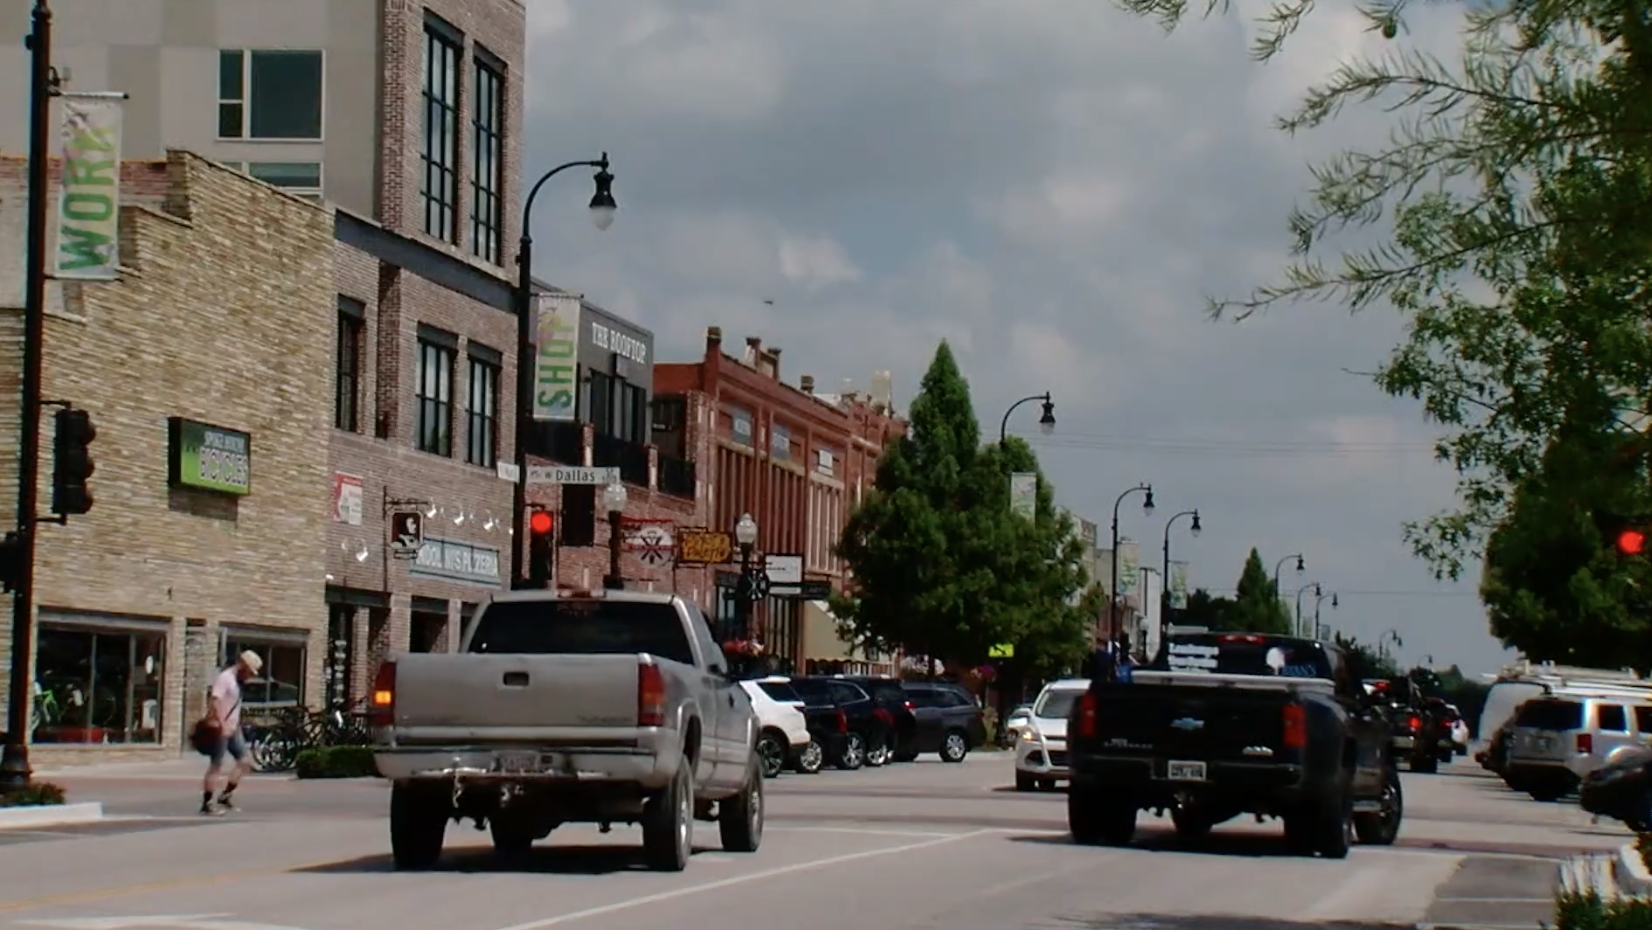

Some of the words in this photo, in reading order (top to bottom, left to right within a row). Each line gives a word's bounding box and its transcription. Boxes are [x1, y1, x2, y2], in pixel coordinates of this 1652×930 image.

[58, 123, 116, 271] WORK
[537, 313, 575, 408] SHOP
[592, 322, 609, 349] THE
[610, 329, 647, 364] ROOFTOP
[556, 469, 595, 482] Dallas
